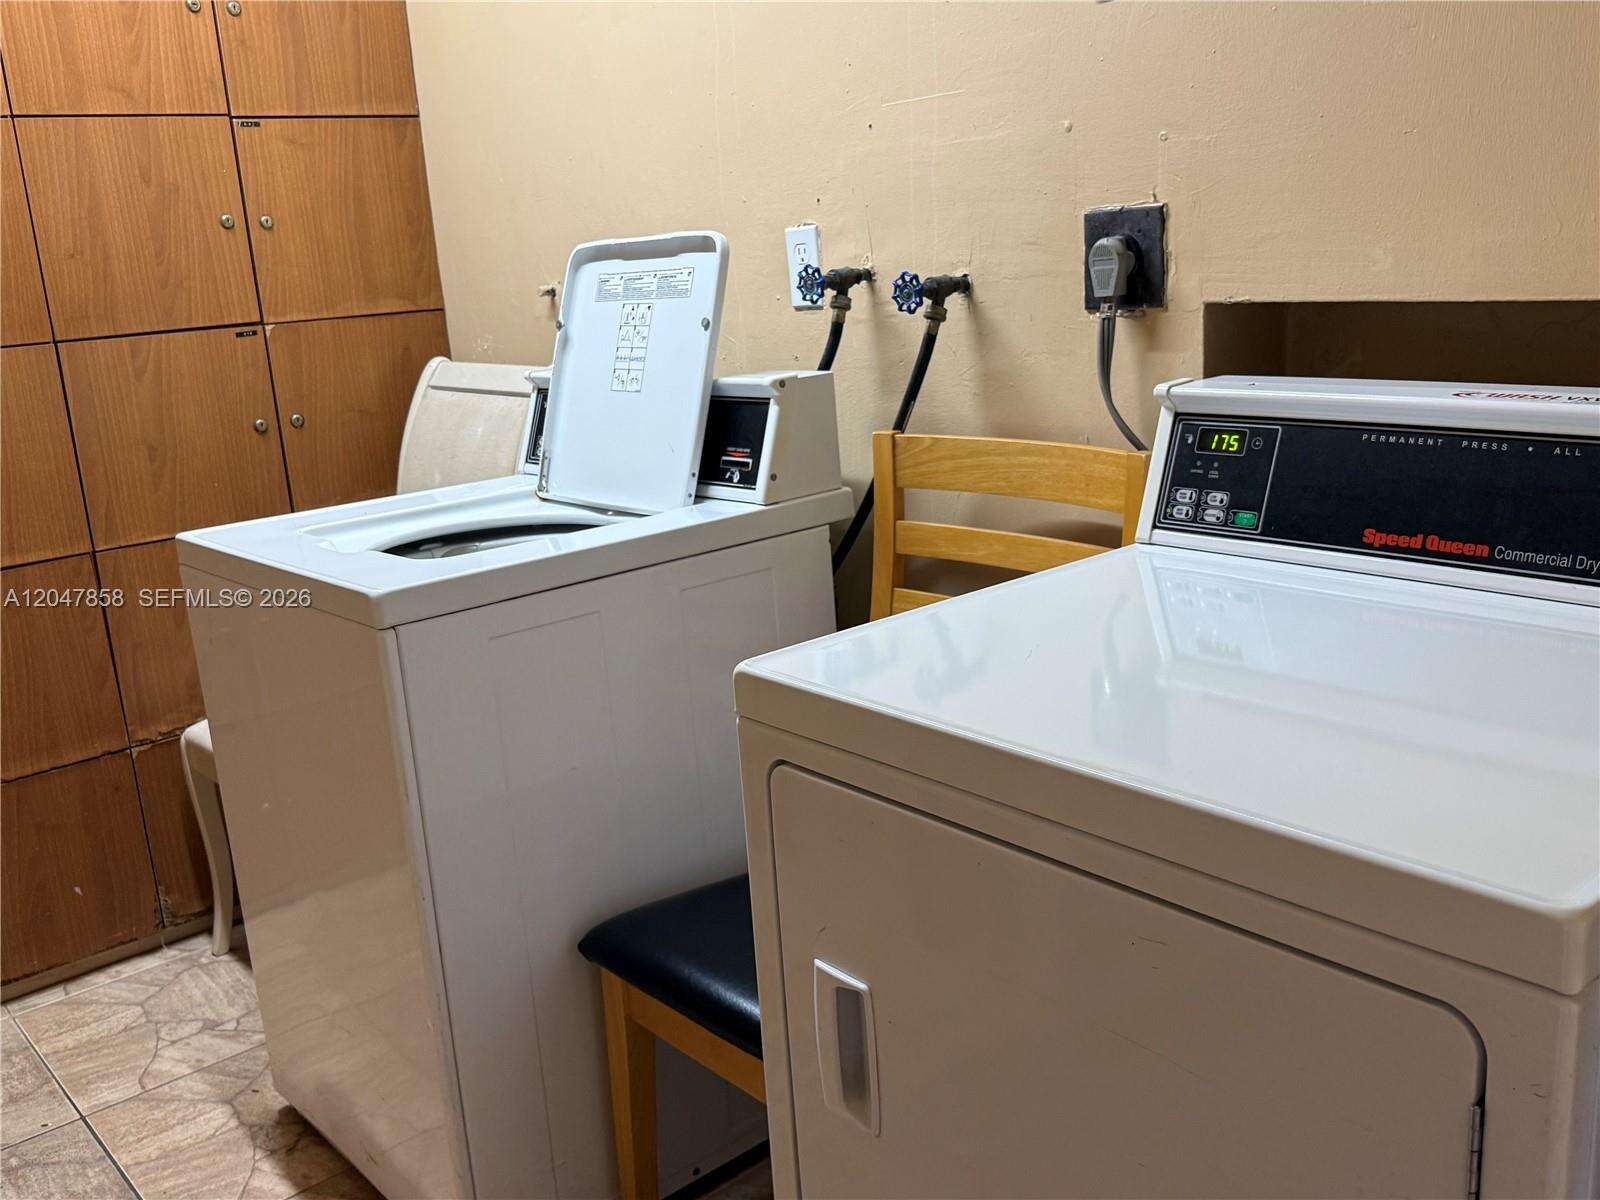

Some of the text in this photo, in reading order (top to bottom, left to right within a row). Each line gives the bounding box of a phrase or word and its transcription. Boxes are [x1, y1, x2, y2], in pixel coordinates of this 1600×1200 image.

[1211, 434, 1240, 452] 175
[1362, 433, 1583, 457] PERMANENT PRESS ALL
[1362, 528, 1424, 549] Speed
[1425, 535, 1490, 558] Queen
[1494, 545, 1573, 568] Commercial
